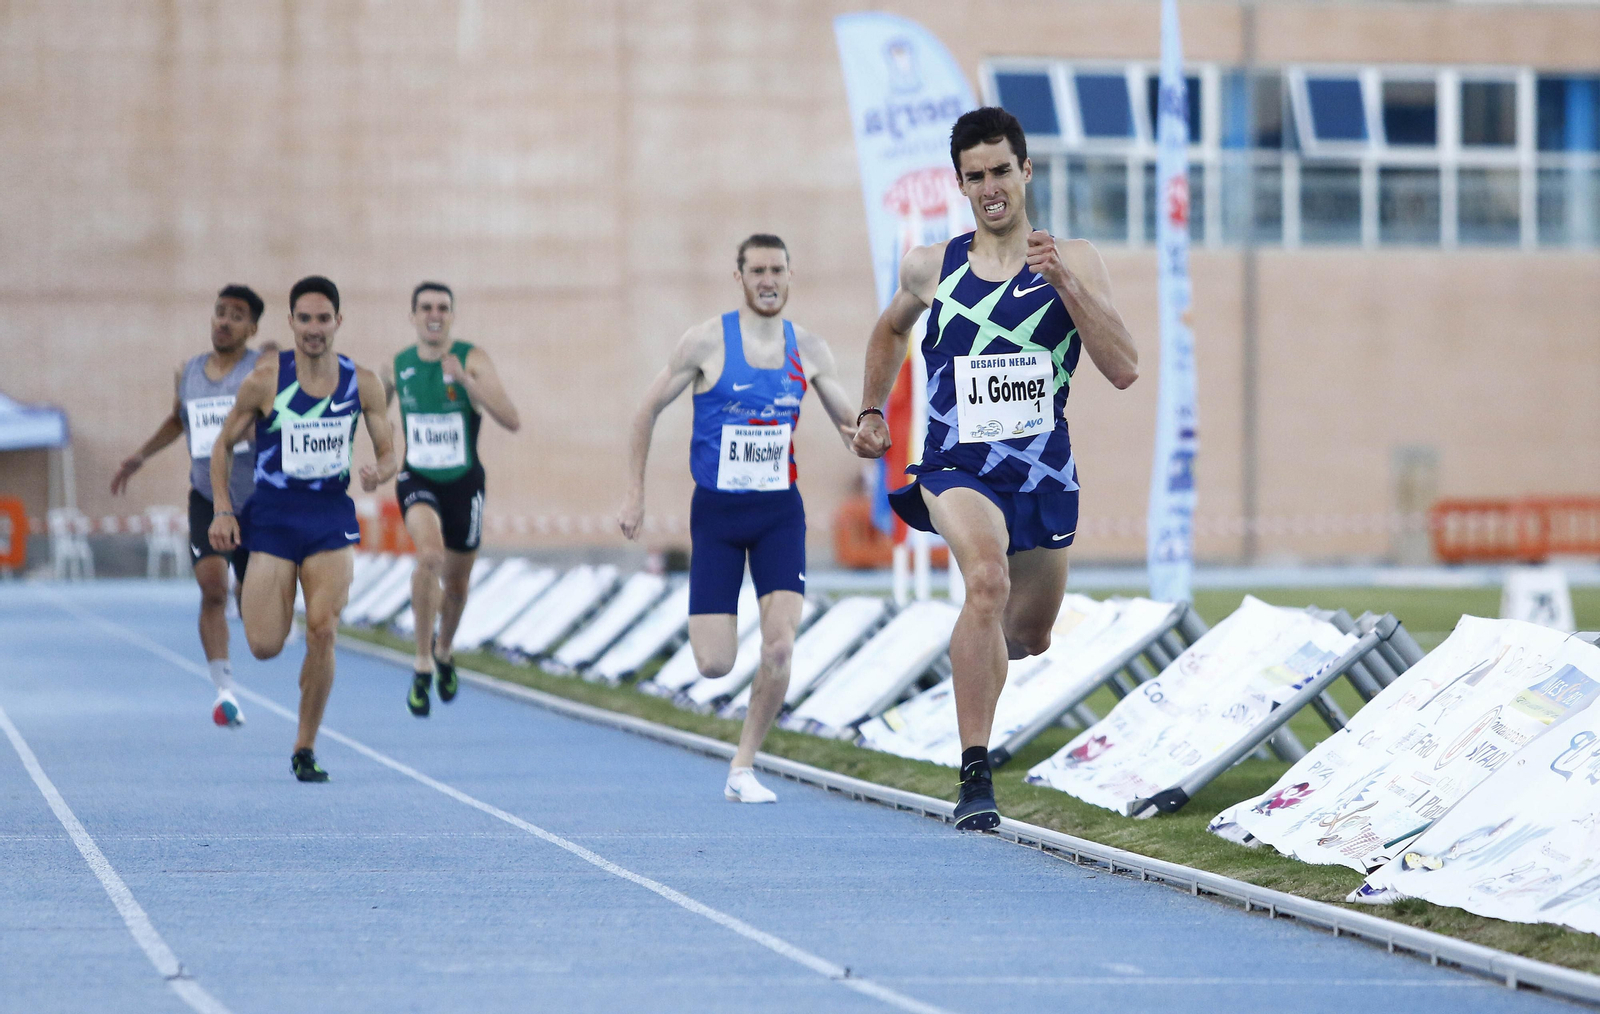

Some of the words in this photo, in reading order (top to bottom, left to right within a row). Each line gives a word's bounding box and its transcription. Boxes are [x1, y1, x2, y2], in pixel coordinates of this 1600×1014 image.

[971, 358, 1006, 369] DESAFÍO
[1009, 356, 1037, 367] NERJA
[968, 377, 983, 405] J.
[988, 375, 1045, 403] Gómez
[1034, 400, 1041, 413] 1
[290, 434, 299, 453] I.
[303, 433, 344, 453] Fontes
[729, 441, 740, 462] B.
[743, 441, 783, 463] Mischler
